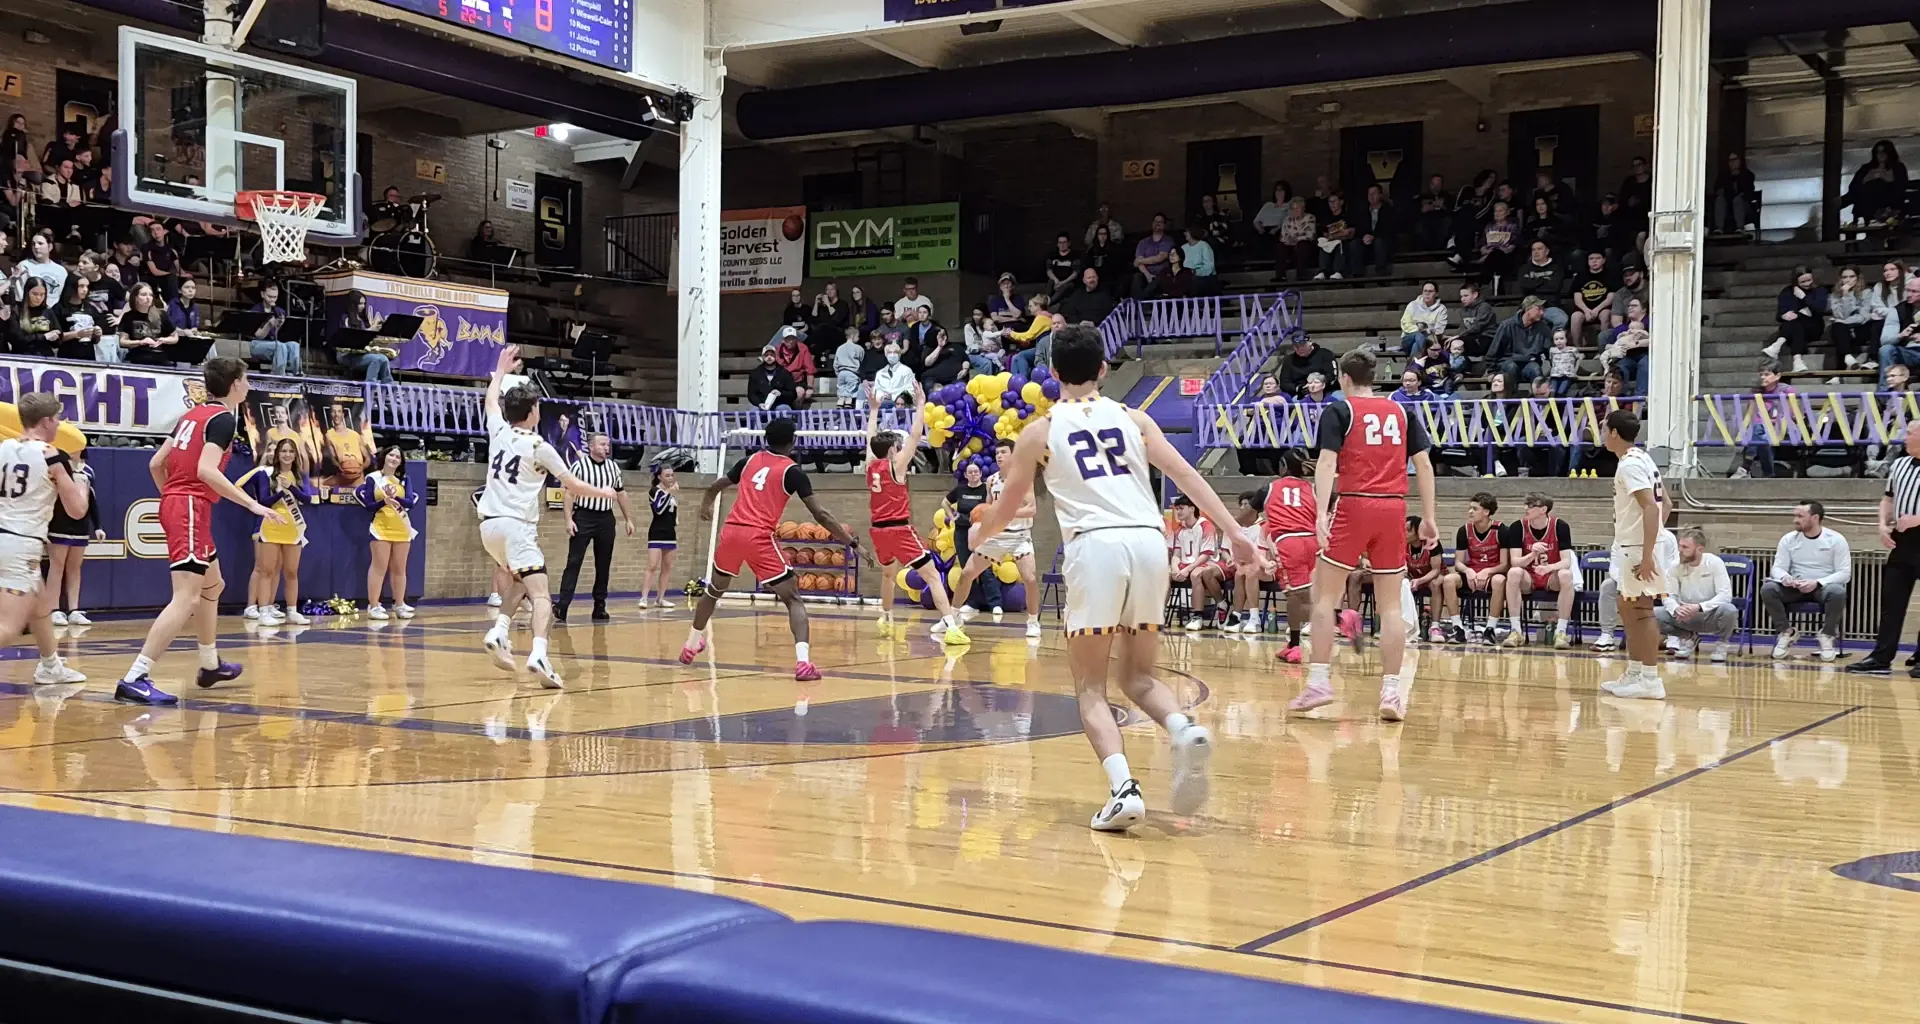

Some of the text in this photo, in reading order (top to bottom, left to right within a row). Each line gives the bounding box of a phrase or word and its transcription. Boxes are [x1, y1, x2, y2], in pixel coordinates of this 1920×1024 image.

[576, 33, 600, 46] Jackson
[4, 75, 17, 91] F
[433, 165, 442, 179] F
[1143, 162, 1155, 177] G
[540, 195, 565, 251] S
[816, 217, 894, 250] GYM
[723, 259, 748, 267] COUNTY
[770, 257, 782, 265] LLC
[172, 419, 197, 451] 14
[1363, 414, 1402, 445] 24
[1068, 427, 1132, 481] 22
[491, 449, 522, 486] 44
[751, 466, 771, 492] 4
[0, 462, 30, 499] 13
[871, 473, 882, 493] 3
[1281, 487, 1302, 507] 11
[1185, 541, 1194, 558] J
